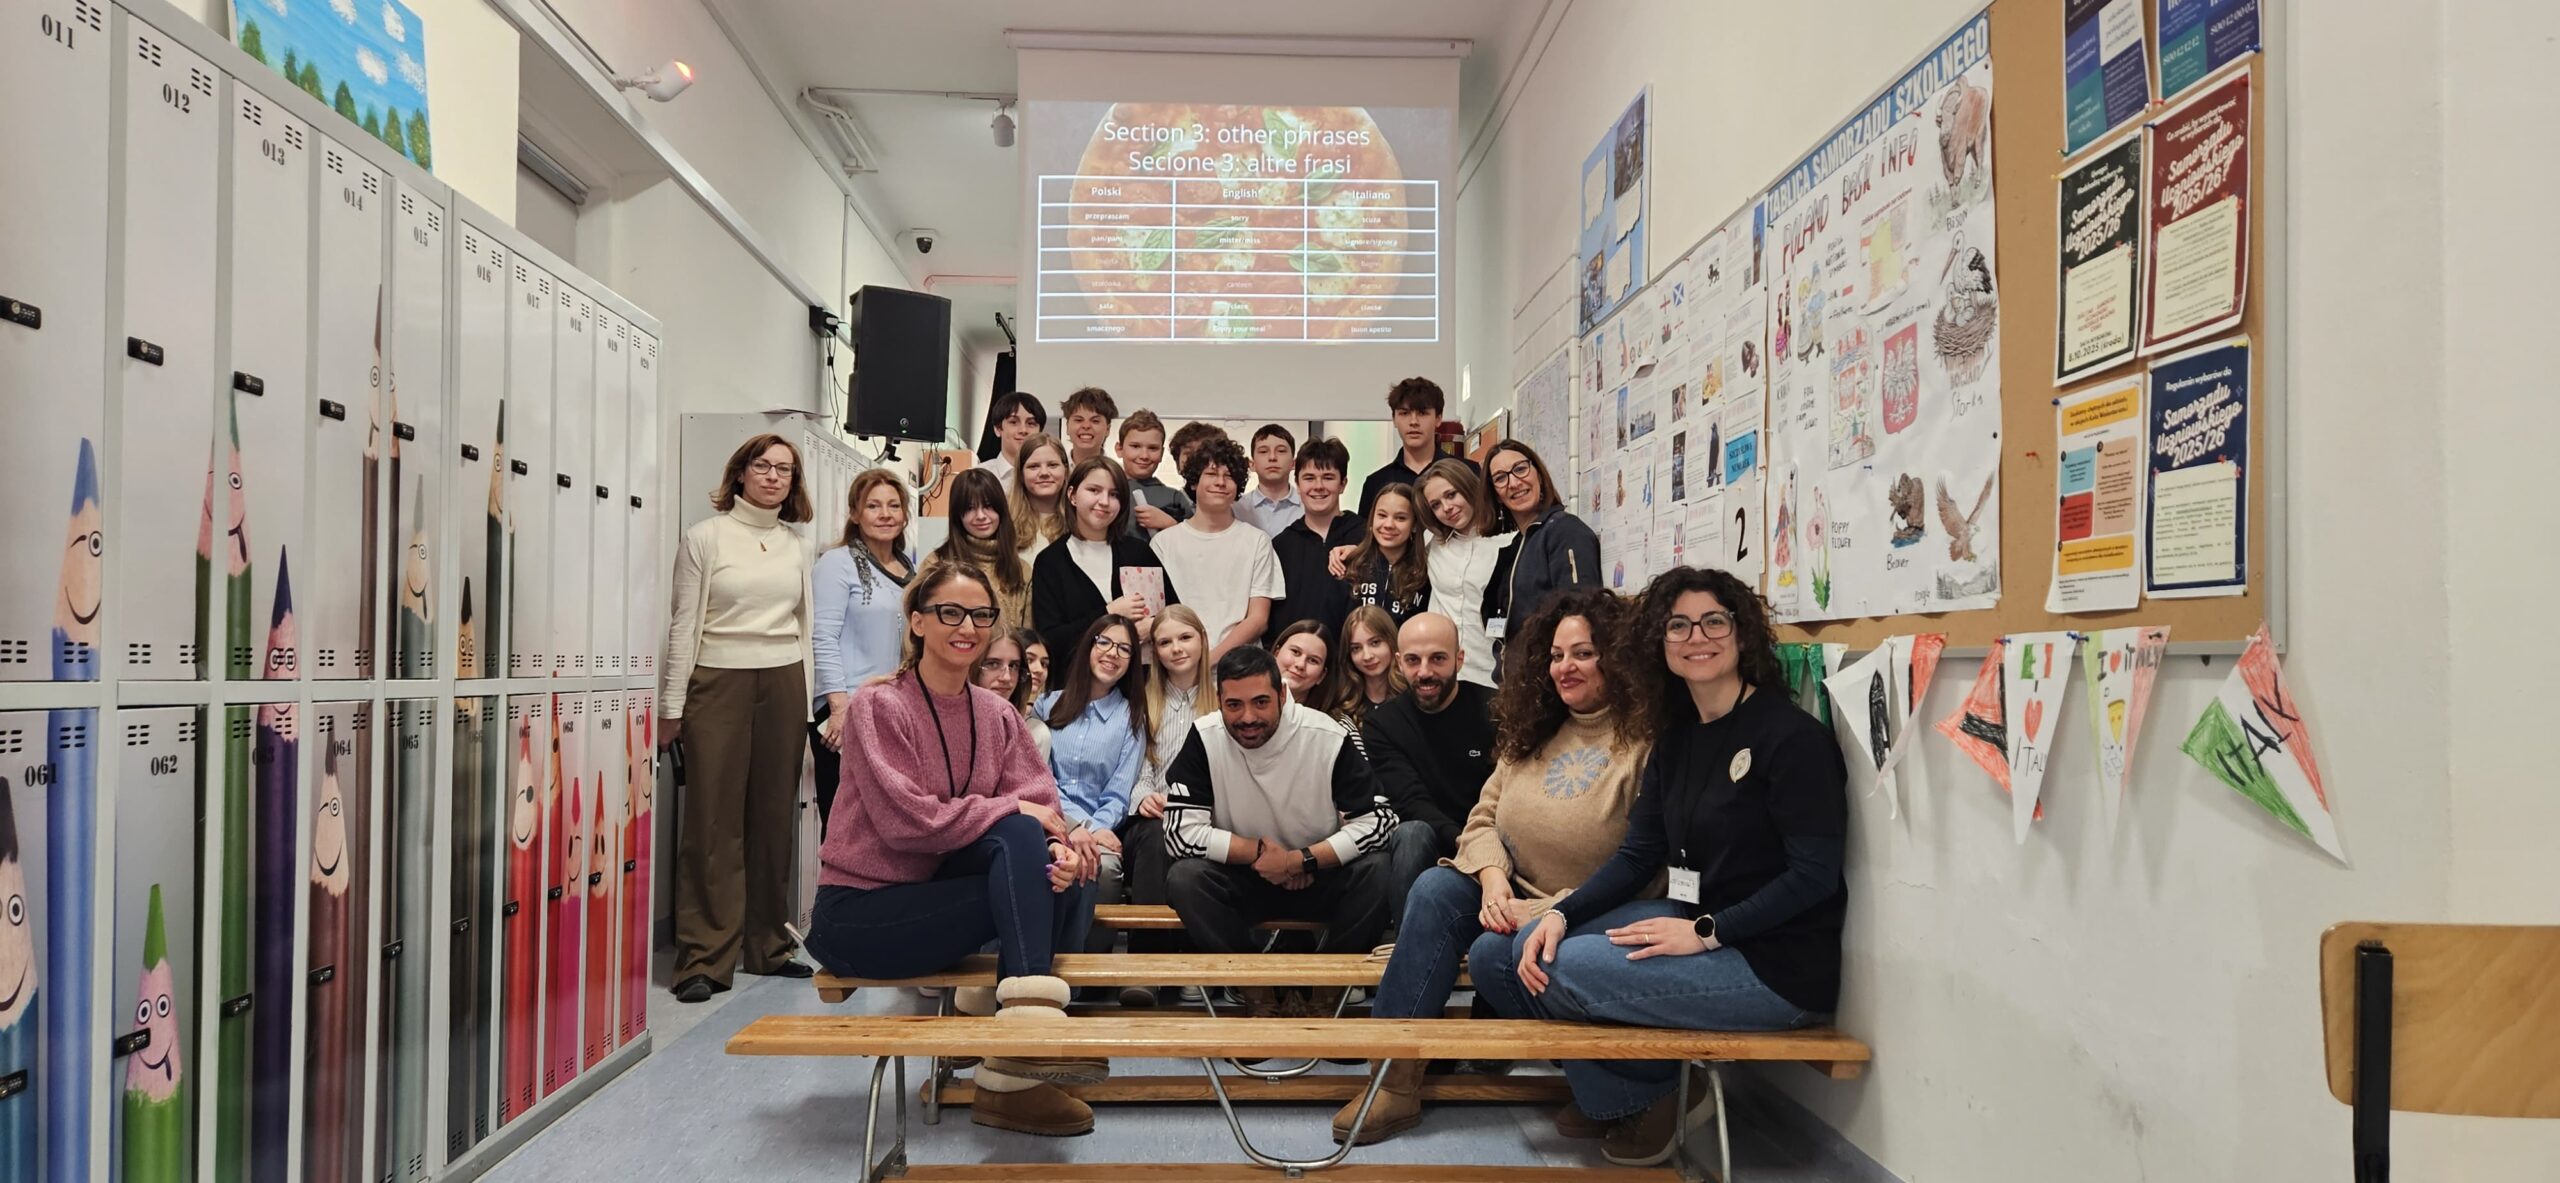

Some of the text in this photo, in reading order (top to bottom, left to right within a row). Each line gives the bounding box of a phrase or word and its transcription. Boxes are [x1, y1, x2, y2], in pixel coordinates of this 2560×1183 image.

[41, 13, 75, 50] 011
[162, 83, 191, 114] 012
[1103, 121, 1370, 148] Section 3: other phrases
[262, 138, 286, 166] 013
[1129, 151, 1351, 174] Secione 3: altre frasi
[343, 187, 364, 212] 014
[1091, 187, 1122, 197] Polski
[1352, 190, 1391, 200] Italiano
[1768, 165, 1811, 223] TABLICA
[413, 226, 429, 248] 015
[2078, 213, 2121, 261] 2025/26
[476, 264, 492, 284] 016
[526, 292, 540, 309] 017
[2172, 425, 2226, 467] 2025/26
[1735, 506, 1748, 563] 2
[562, 721, 575, 733] 068
[601, 720, 612, 731] 069
[333, 739, 352, 756] 064
[402, 734, 420, 751] 065
[23, 762, 58, 788] 061
[150, 754, 179, 777] 062
